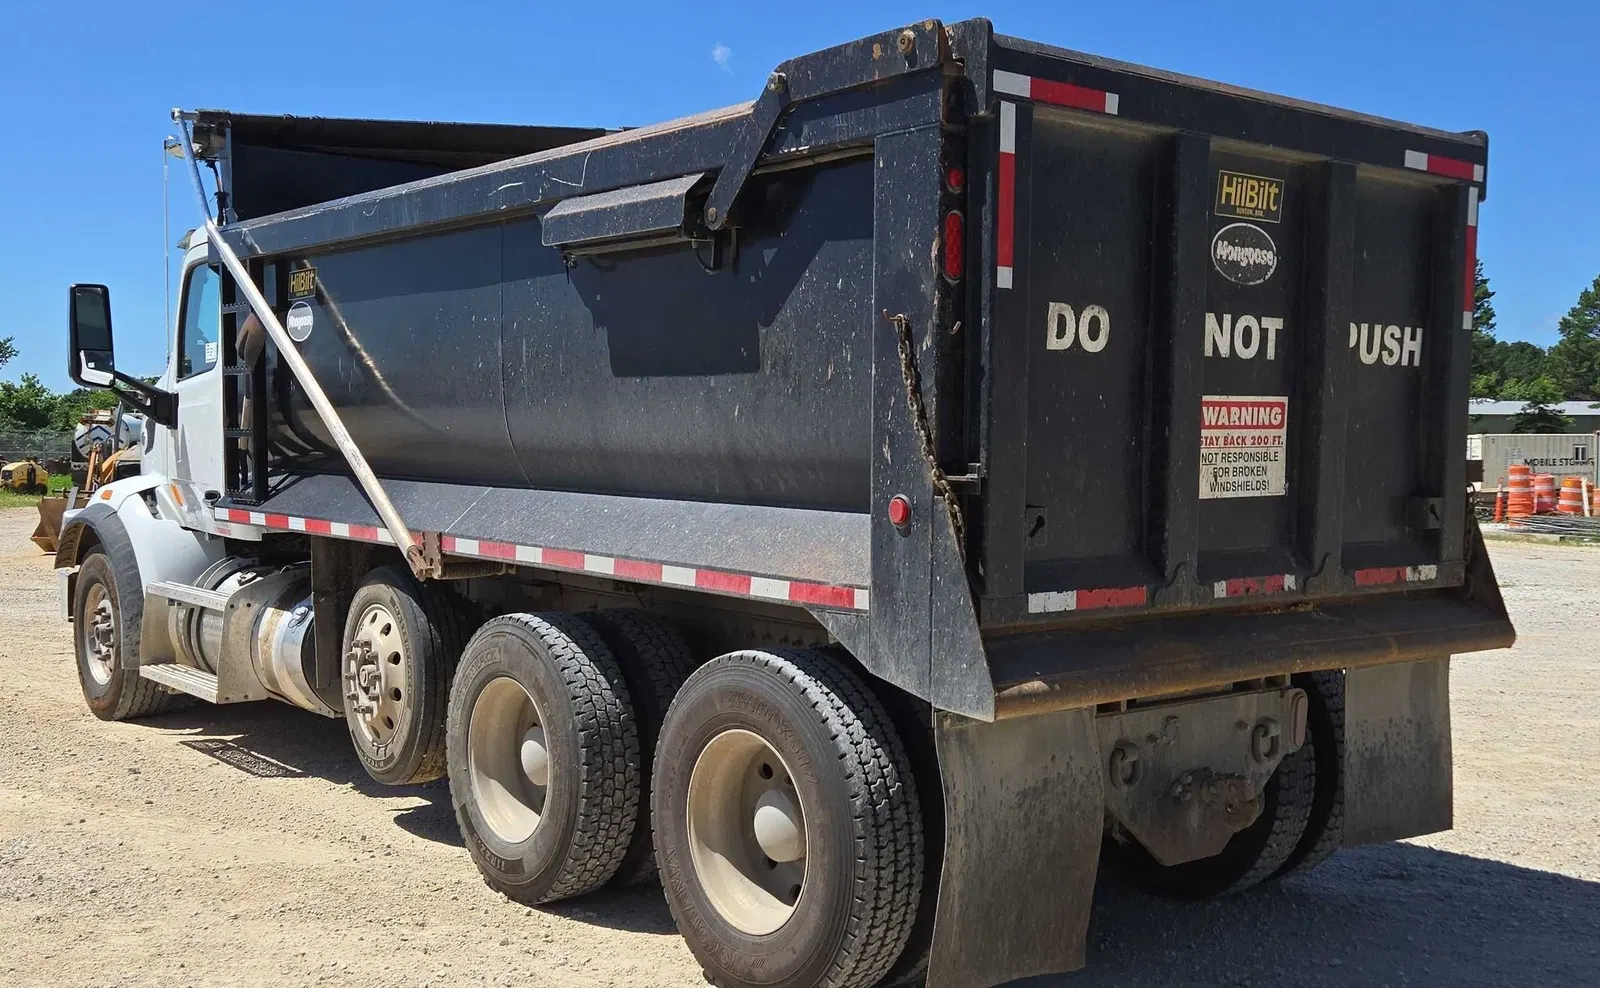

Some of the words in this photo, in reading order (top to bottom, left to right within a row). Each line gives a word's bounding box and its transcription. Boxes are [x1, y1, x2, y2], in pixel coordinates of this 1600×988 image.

[1221, 175, 1279, 212] HilBilt
[1216, 240, 1274, 267] Mongoose
[290, 269, 314, 293] HilBilt
[1046, 301, 1110, 353] DO
[1204, 312, 1283, 360] NOT
[1202, 406, 1282, 426] WARNING
[1223, 435, 1247, 446] BACK
[1251, 435, 1269, 446] 200
[1272, 435, 1284, 446] FT.
[1202, 452, 1219, 464] NOT
[1221, 451, 1279, 464] RESPONSIBLE
[1524, 458, 1557, 467] MOBILE
[1213, 467, 1230, 478] FOR
[1232, 466, 1267, 477] BROKEN
[1209, 480, 1270, 493] WINDSHIELDS!
